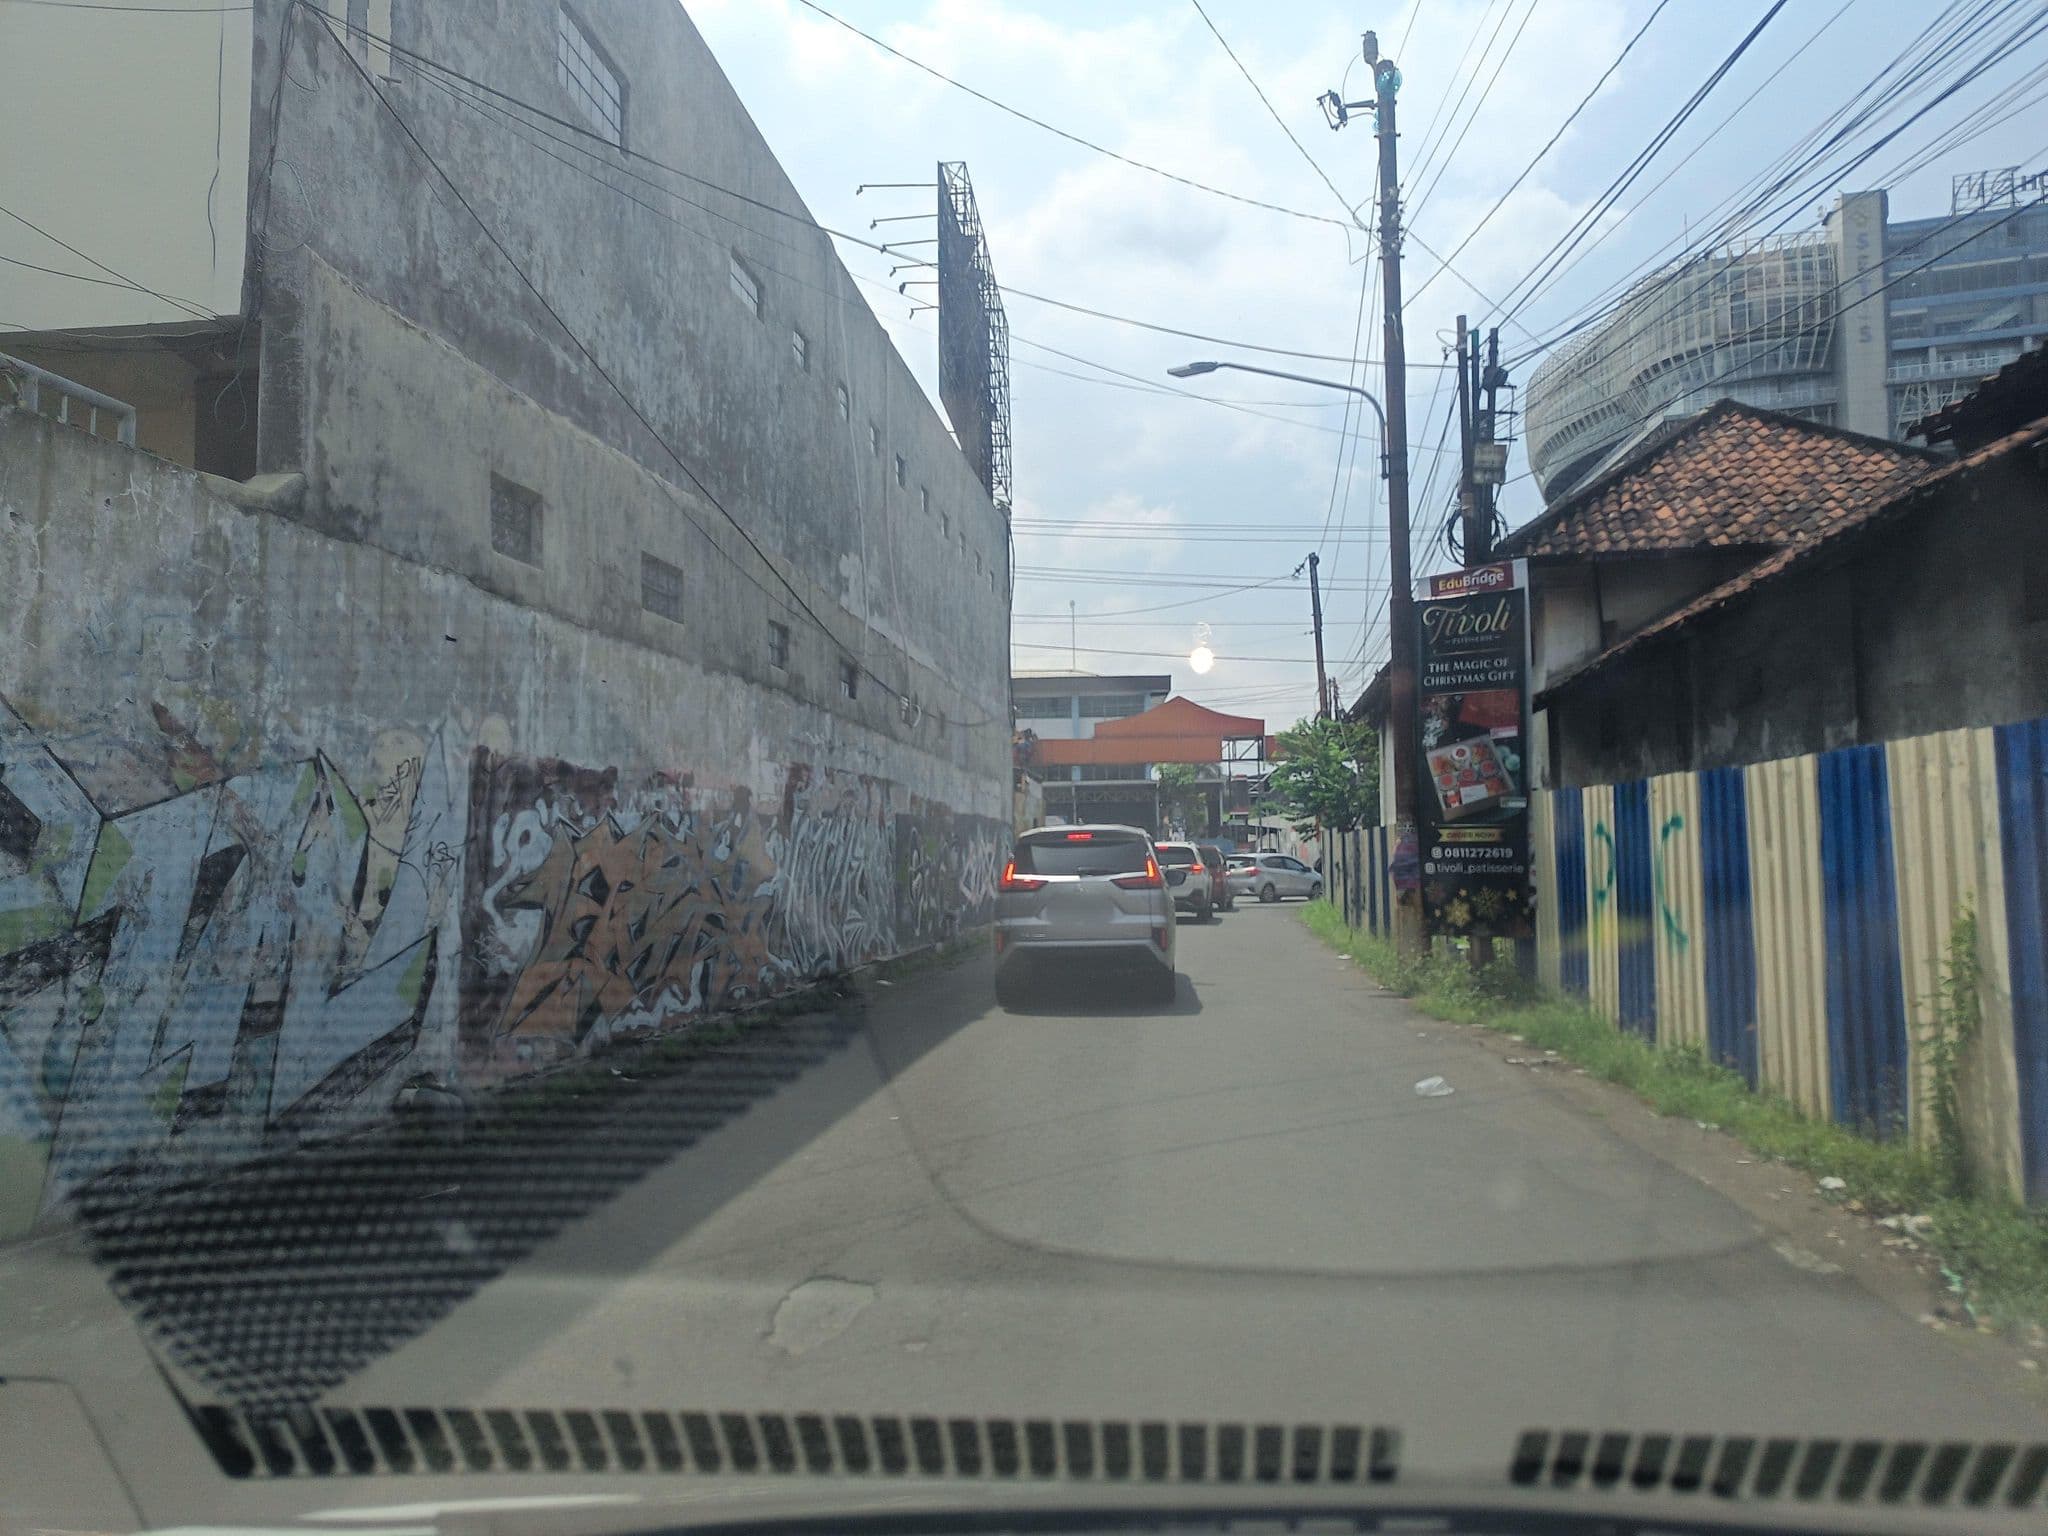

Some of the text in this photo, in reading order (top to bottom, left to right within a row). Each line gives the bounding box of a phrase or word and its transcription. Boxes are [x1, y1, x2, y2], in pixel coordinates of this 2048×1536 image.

[1438, 571, 1505, 591] EduBridge
[1422, 597, 1511, 644] Tivoli
[1428, 657, 1509, 673] THE MAGIC OF
[1423, 671, 1515, 687] CHRISTMAS GIFT
